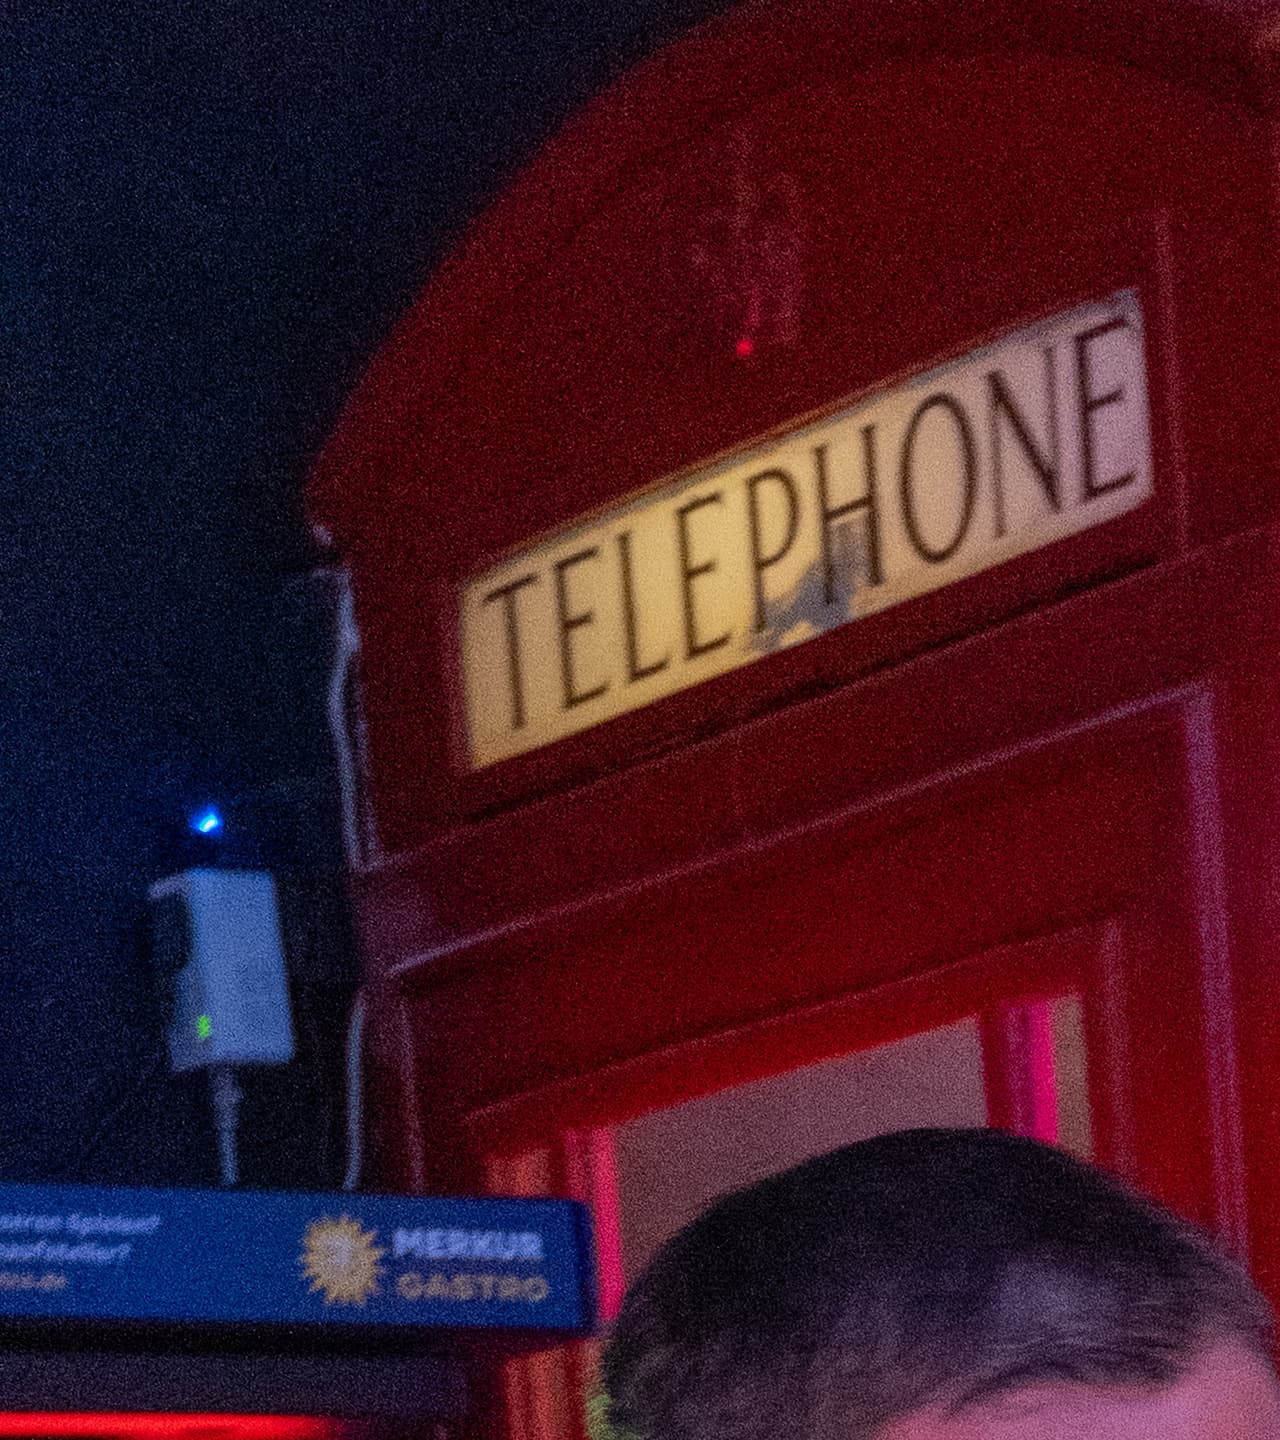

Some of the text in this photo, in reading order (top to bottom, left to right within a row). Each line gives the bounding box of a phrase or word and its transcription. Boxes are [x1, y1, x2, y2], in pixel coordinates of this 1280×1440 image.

[483, 316, 1136, 730] TELEPHONE
[394, 1227, 544, 1261] MERKUR
[397, 1272, 549, 1302] GASTRO
